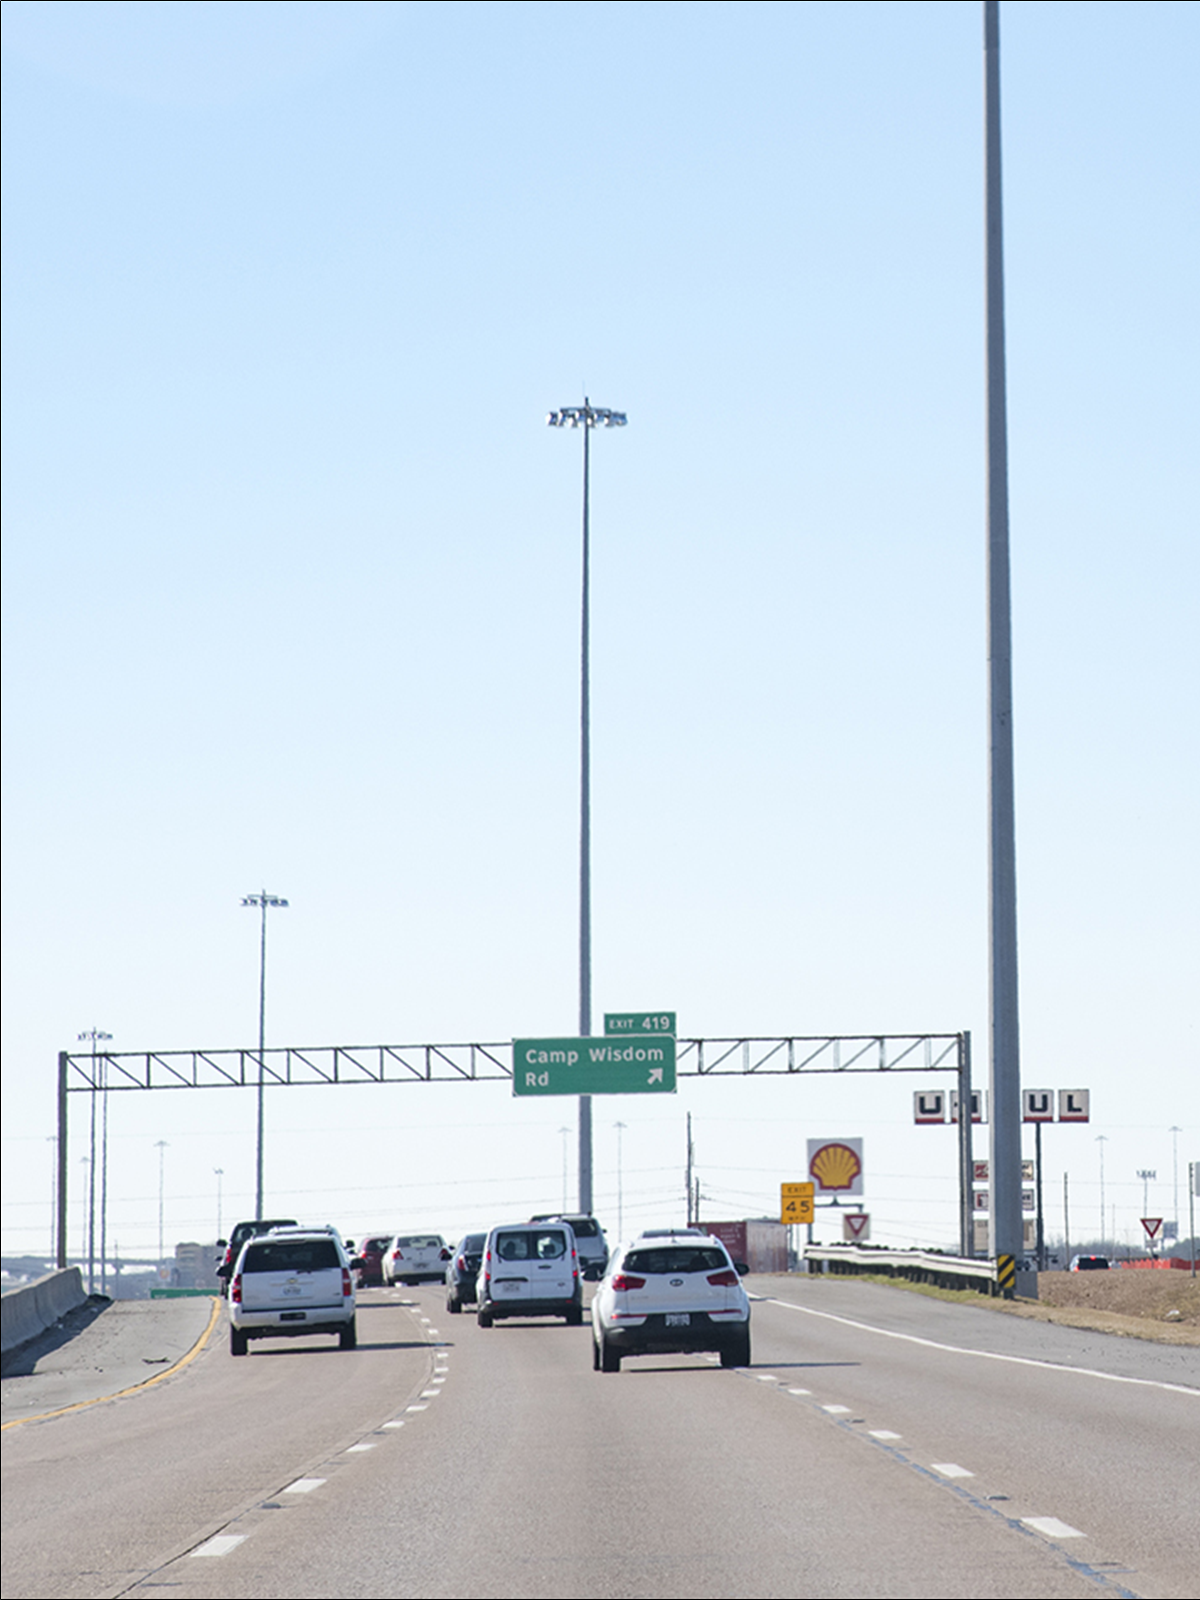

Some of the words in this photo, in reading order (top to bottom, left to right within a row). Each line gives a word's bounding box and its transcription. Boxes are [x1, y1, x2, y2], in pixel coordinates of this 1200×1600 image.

[609, 1018, 634, 1029] EXIT
[642, 1016, 670, 1030] 419
[525, 1049, 579, 1066] Camp
[589, 1046, 664, 1062] Wisdom
[525, 1072, 549, 1087] Rd
[785, 1200, 810, 1213] 45
